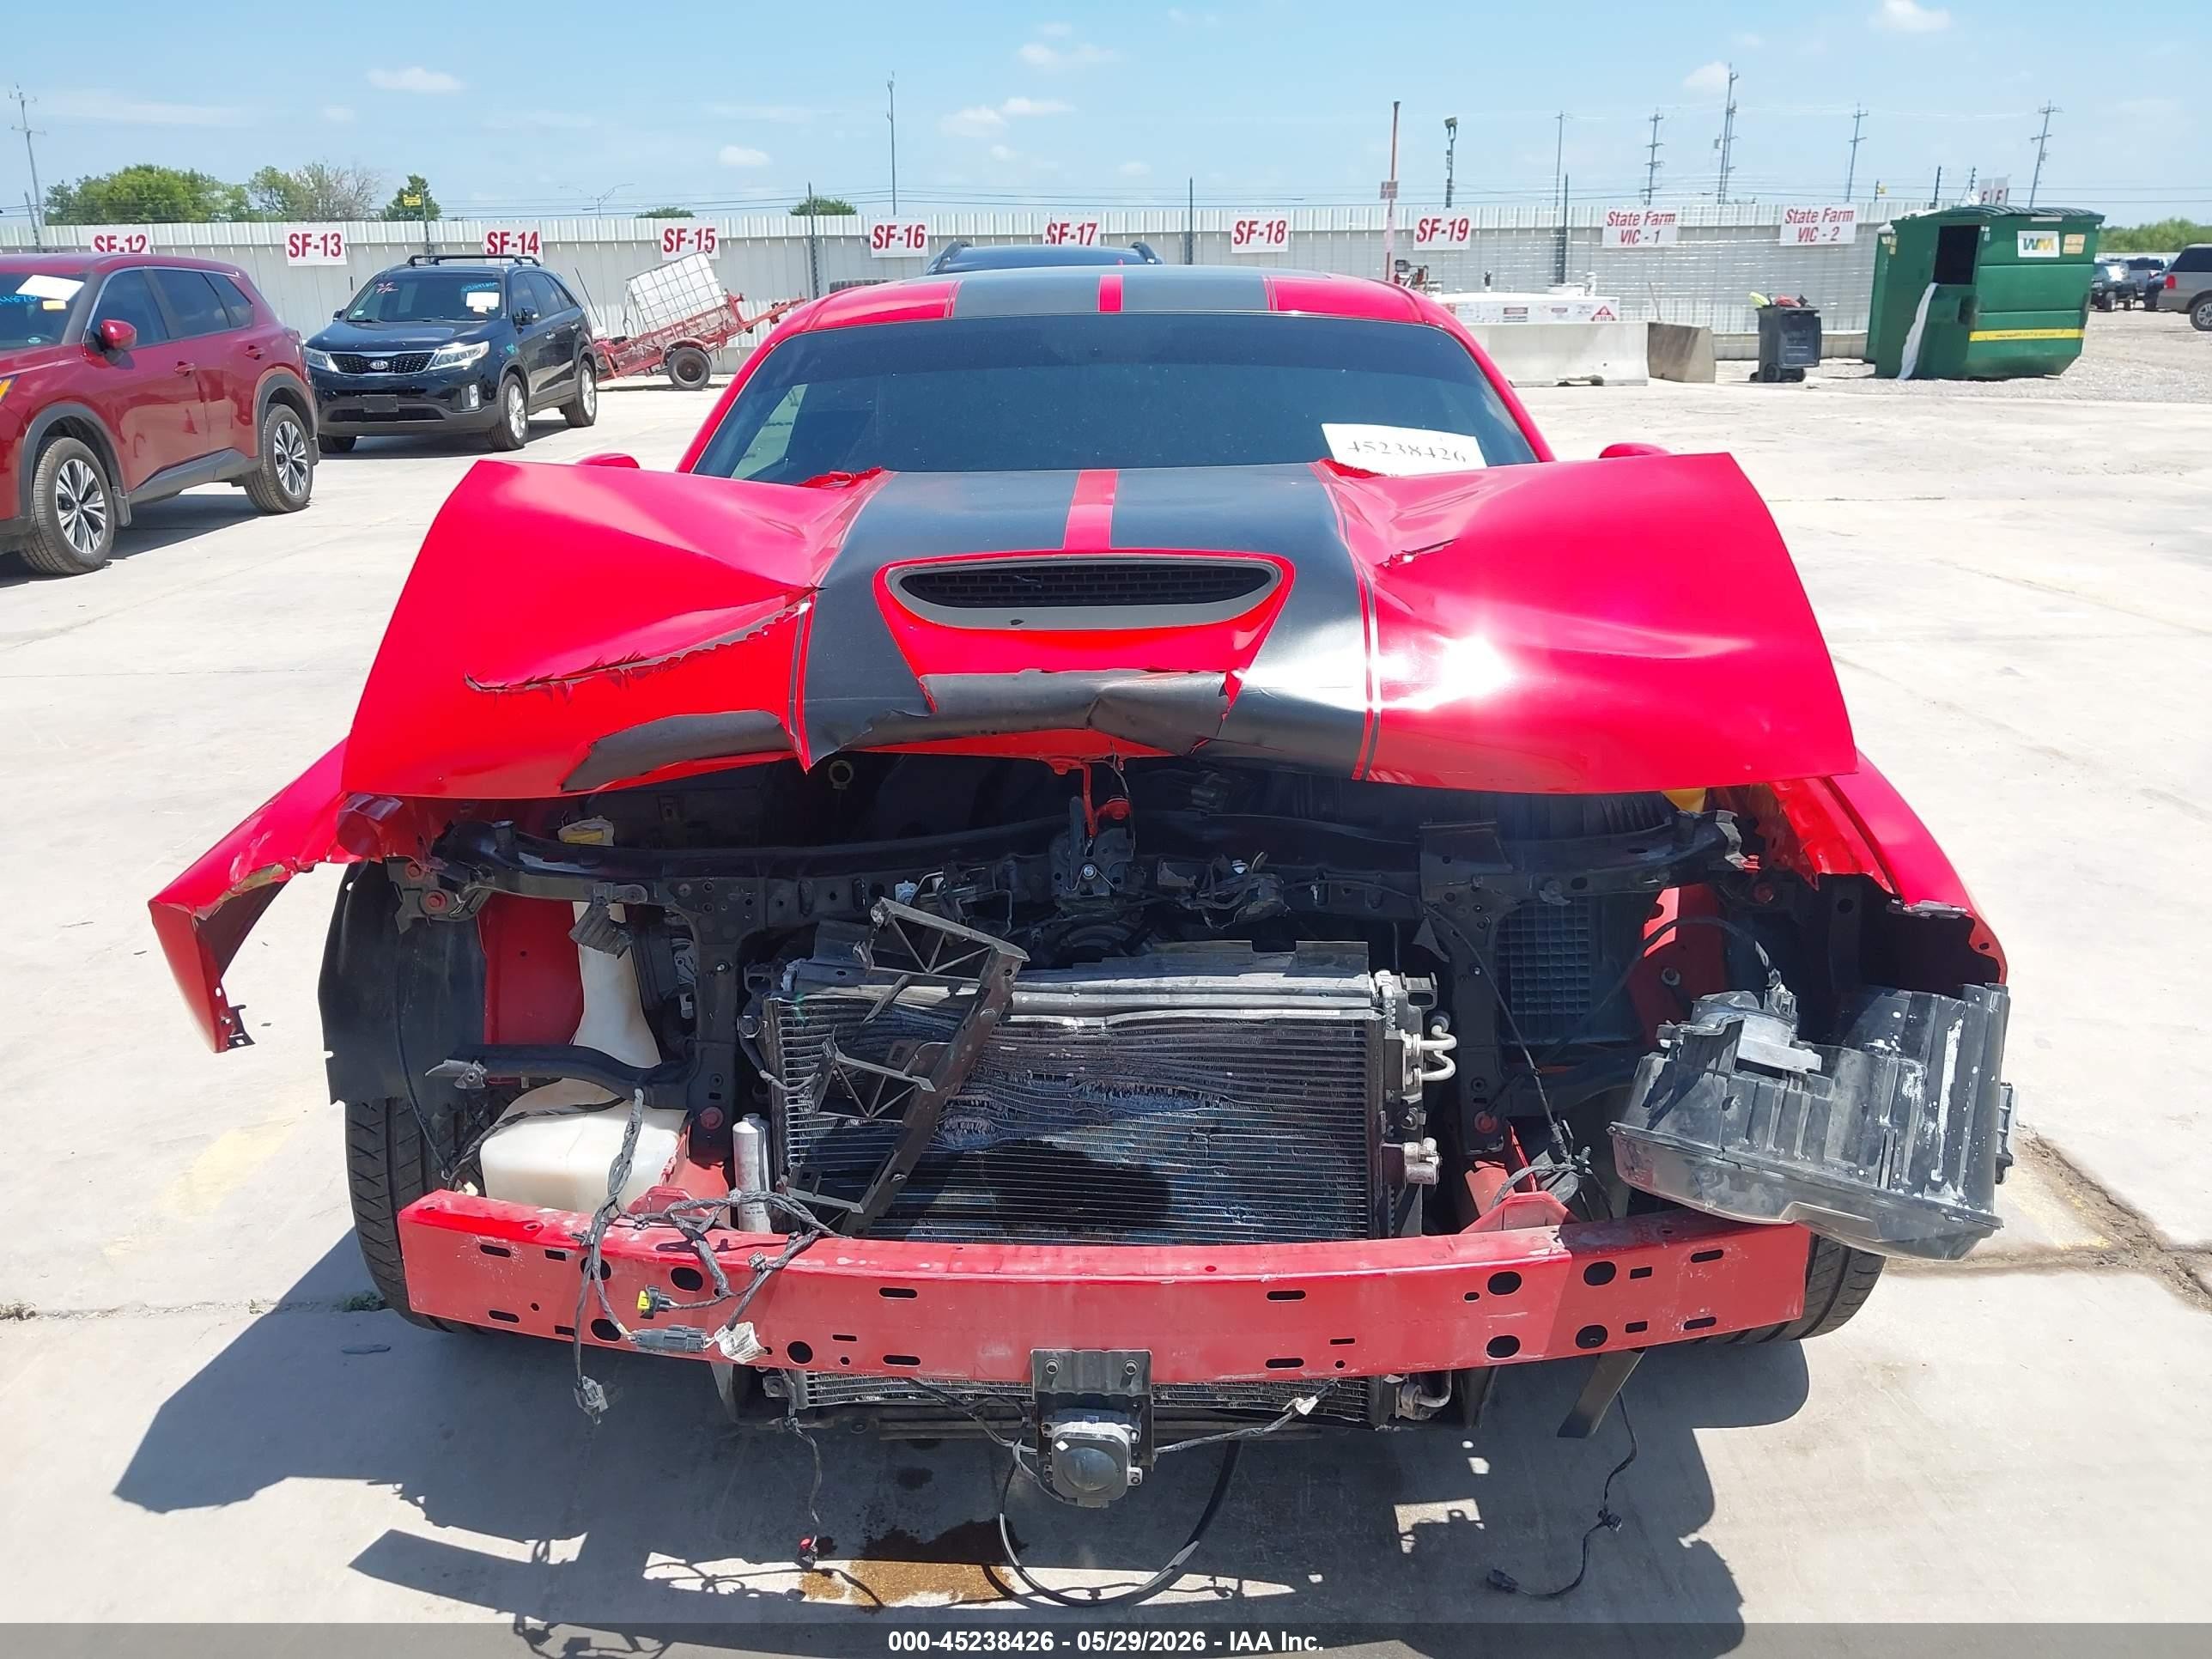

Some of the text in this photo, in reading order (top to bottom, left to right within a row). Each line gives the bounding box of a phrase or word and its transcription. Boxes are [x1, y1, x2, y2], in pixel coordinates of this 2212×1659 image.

[1607, 211, 1676, 227] State Farm
[1785, 207, 1854, 223] State Farm
[663, 228, 715, 253] SF-15
[872, 224, 926, 249] SF-16
[1045, 222, 1097, 246] SF-17
[1233, 220, 1286, 245] SF-18
[1416, 218, 1469, 242] SF-19
[1620, 229, 1641, 245] VIC
[1654, 229, 1661, 244] 1
[1797, 227, 1819, 242] VIC
[1830, 226, 1839, 241] 2
[94, 234, 146, 253] SF-12
[289, 233, 342, 258] SF-13
[487, 231, 539, 255] SF-14
[2023, 238, 2054, 250] WM
[1348, 441, 1467, 463] 45238426
